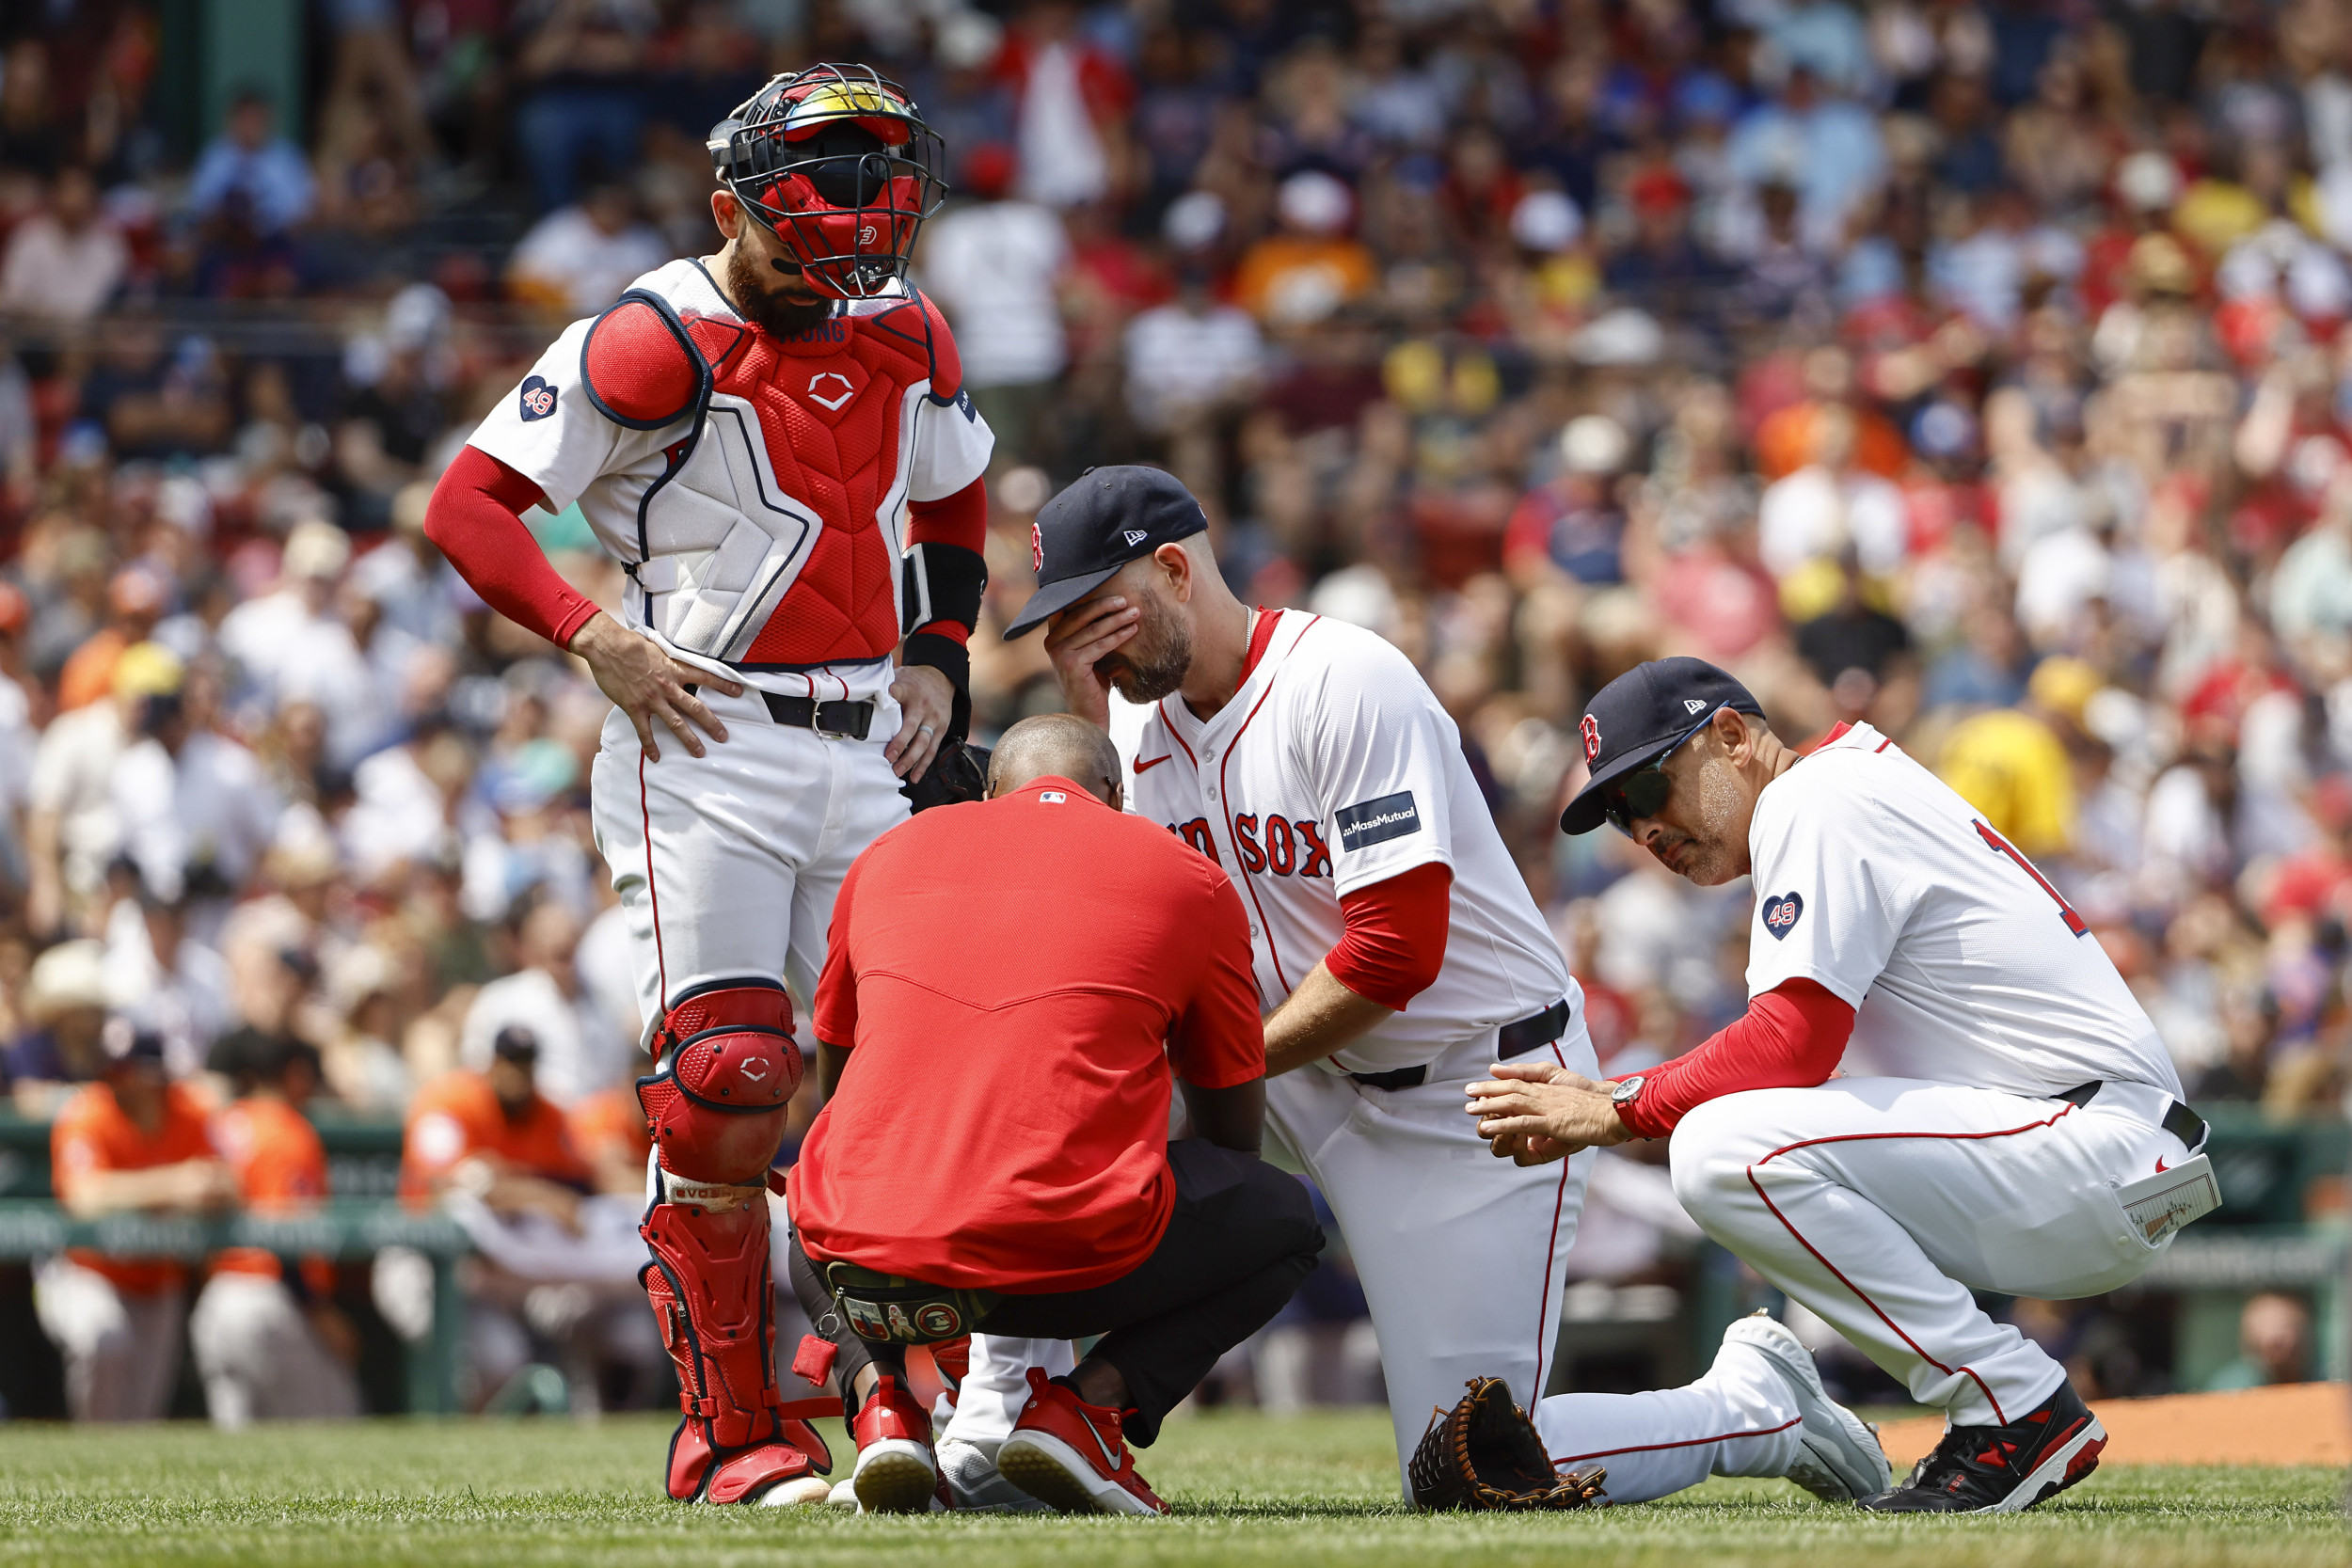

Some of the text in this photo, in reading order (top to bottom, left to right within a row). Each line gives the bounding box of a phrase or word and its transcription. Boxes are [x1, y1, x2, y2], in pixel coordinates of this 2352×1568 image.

[779, 321, 845, 343] ONG
[523, 388, 553, 415] 49
[1579, 714, 1602, 766] B
[1351, 806, 1416, 832] MassMutual
[1234, 812, 1334, 879] SOX
[1970, 818, 2090, 939] 1
[1768, 901, 1796, 927] 49
